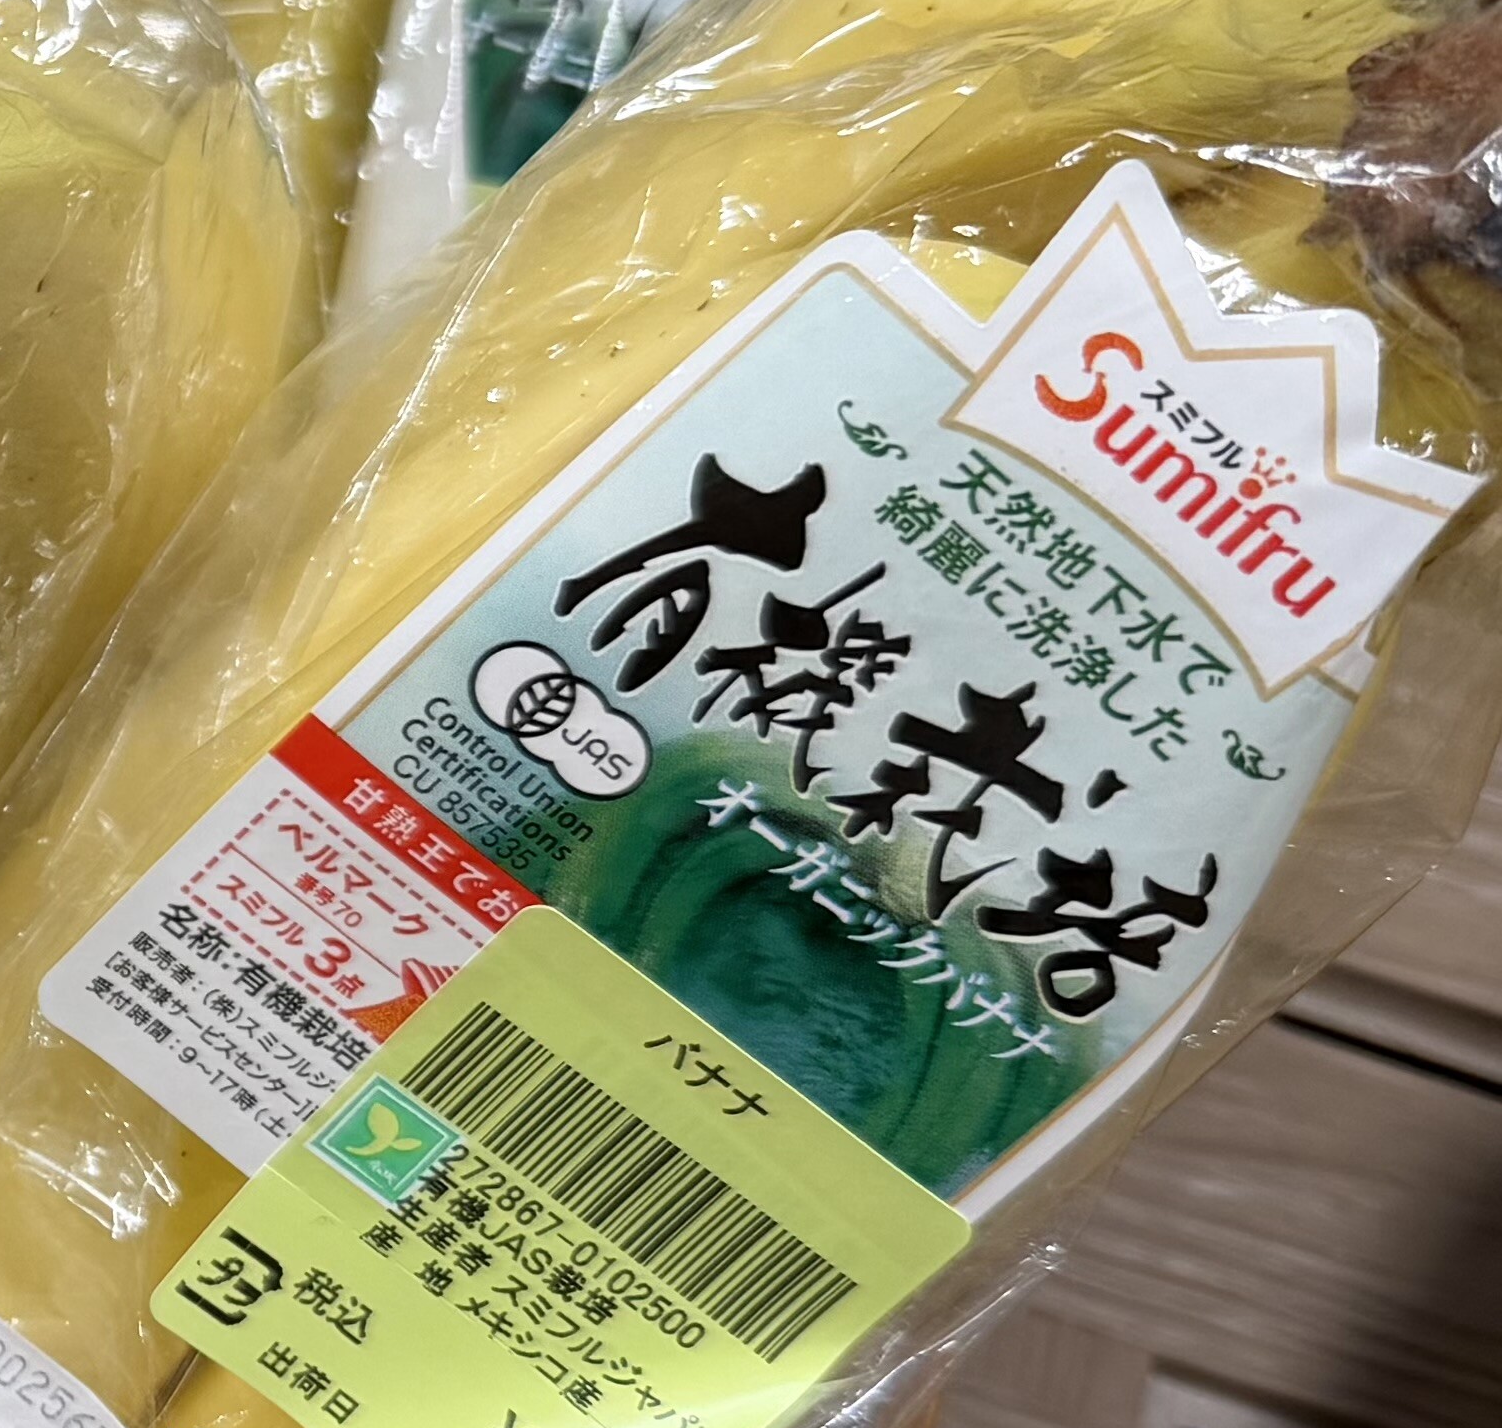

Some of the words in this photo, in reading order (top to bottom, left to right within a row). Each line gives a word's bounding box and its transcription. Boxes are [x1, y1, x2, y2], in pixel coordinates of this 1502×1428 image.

[1034, 332, 1337, 619] Sumifru
[1140, 379, 1242, 471] スミフル
[873, 485, 1189, 763] 綺麗に洗浄した
[939, 447, 1233, 697] 天然地下水で
[400, 718, 573, 863] Certifications
[423, 696, 523, 781] Control
[517, 773, 595, 844] Union
[554, 452, 1219, 1018] 有機栽培
[561, 727, 634, 781] JAS
[277, 820, 430, 938] ベルマーク
[342, 776, 520, 923] 甘熟王でお
[392, 754, 443, 795] CU
[436, 790, 539, 871] 857535
[215, 873, 305, 949] スミフル
[303, 936, 367, 999] 3点
[294, 871, 363, 929] 番号70
[696, 778, 1057, 1060] オーガニックバナナ
[127, 930, 337, 1095] 販売者：(株)スミフルジ
[157, 901, 372, 1073] 名称：有機栽培
[644, 1034, 771, 1122] バナナ
[291, 1266, 381, 1345] 税込
[386, 1194, 493, 1276] 生産者
[416, 1167, 620, 1331] 有機JAS栽培
[441, 1144, 706, 1352] 272867-0102500
[256, 1341, 362, 1426] 出荷日
[358, 1216, 405, 1261] 産
[413, 1258, 456, 1297] 地
[457, 1292, 607, 1417] メキシコ産
